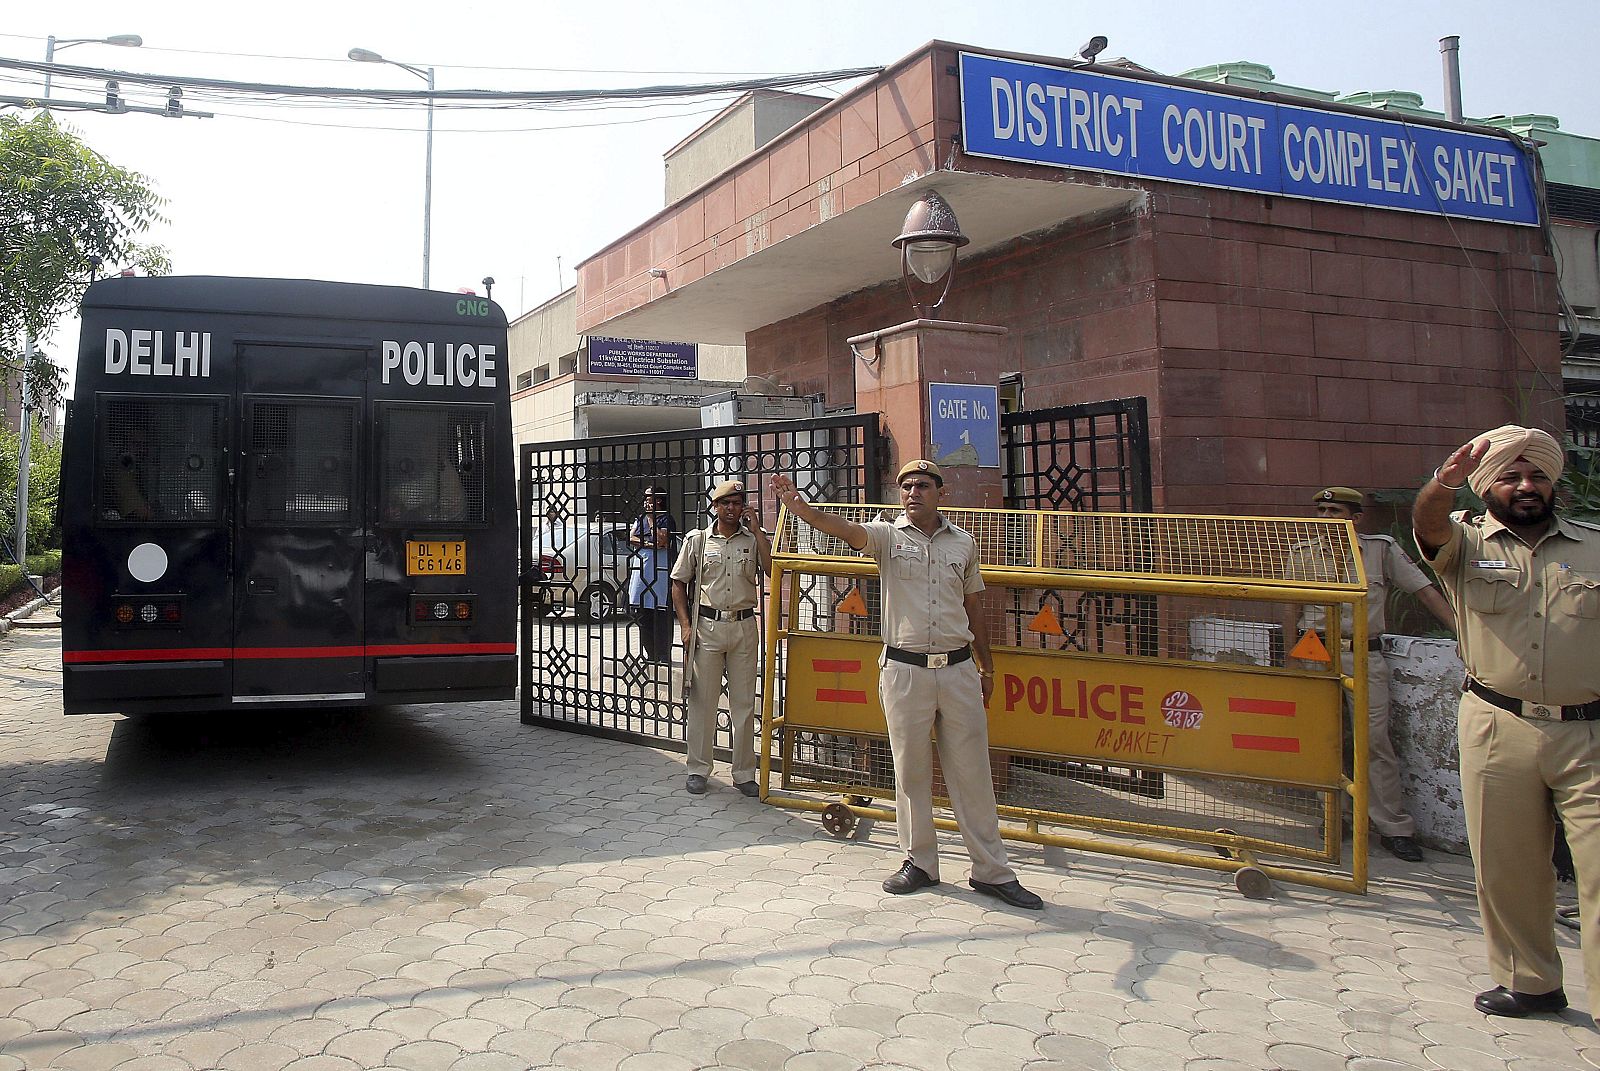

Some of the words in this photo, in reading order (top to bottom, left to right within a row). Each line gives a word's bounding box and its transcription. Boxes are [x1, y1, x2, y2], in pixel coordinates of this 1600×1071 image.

[990, 76, 1142, 158] DISTRICT
[1162, 104, 1265, 176] COURT
[1283, 122, 1420, 196] COMPLEX
[1433, 145, 1515, 208] SAKET
[456, 300, 489, 317] CNG
[104, 328, 211, 377] DELHI
[381, 340, 497, 388] POLICE
[938, 398, 968, 419] GATE
[973, 400, 990, 420] No.
[959, 429, 970, 445] 1
[418, 544, 432, 556] DL
[441, 544, 446, 556] 1
[455, 544, 462, 556] P
[418, 558, 462, 571] C6146
[1004, 673, 1146, 725] POLICE
[1165, 691, 1189, 707] SD
